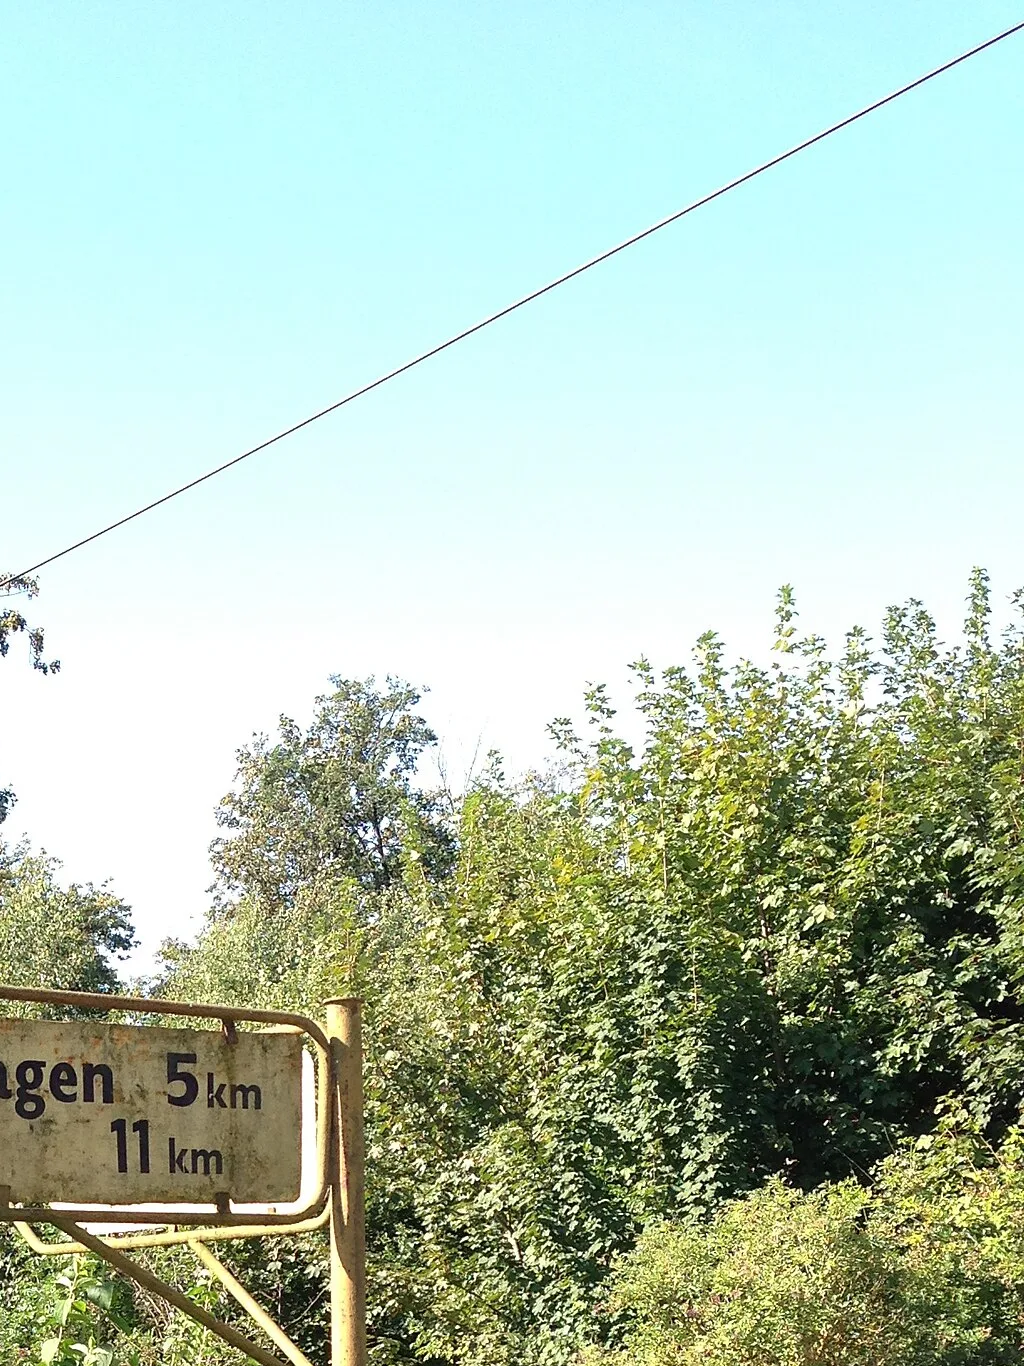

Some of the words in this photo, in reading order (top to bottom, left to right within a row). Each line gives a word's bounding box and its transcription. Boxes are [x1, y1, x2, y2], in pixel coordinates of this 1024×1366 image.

[167, 1053, 199, 1107] 5
[207, 1072, 262, 1110] km
[110, 1118, 150, 1174] 11
[168, 1137, 223, 1175] km
